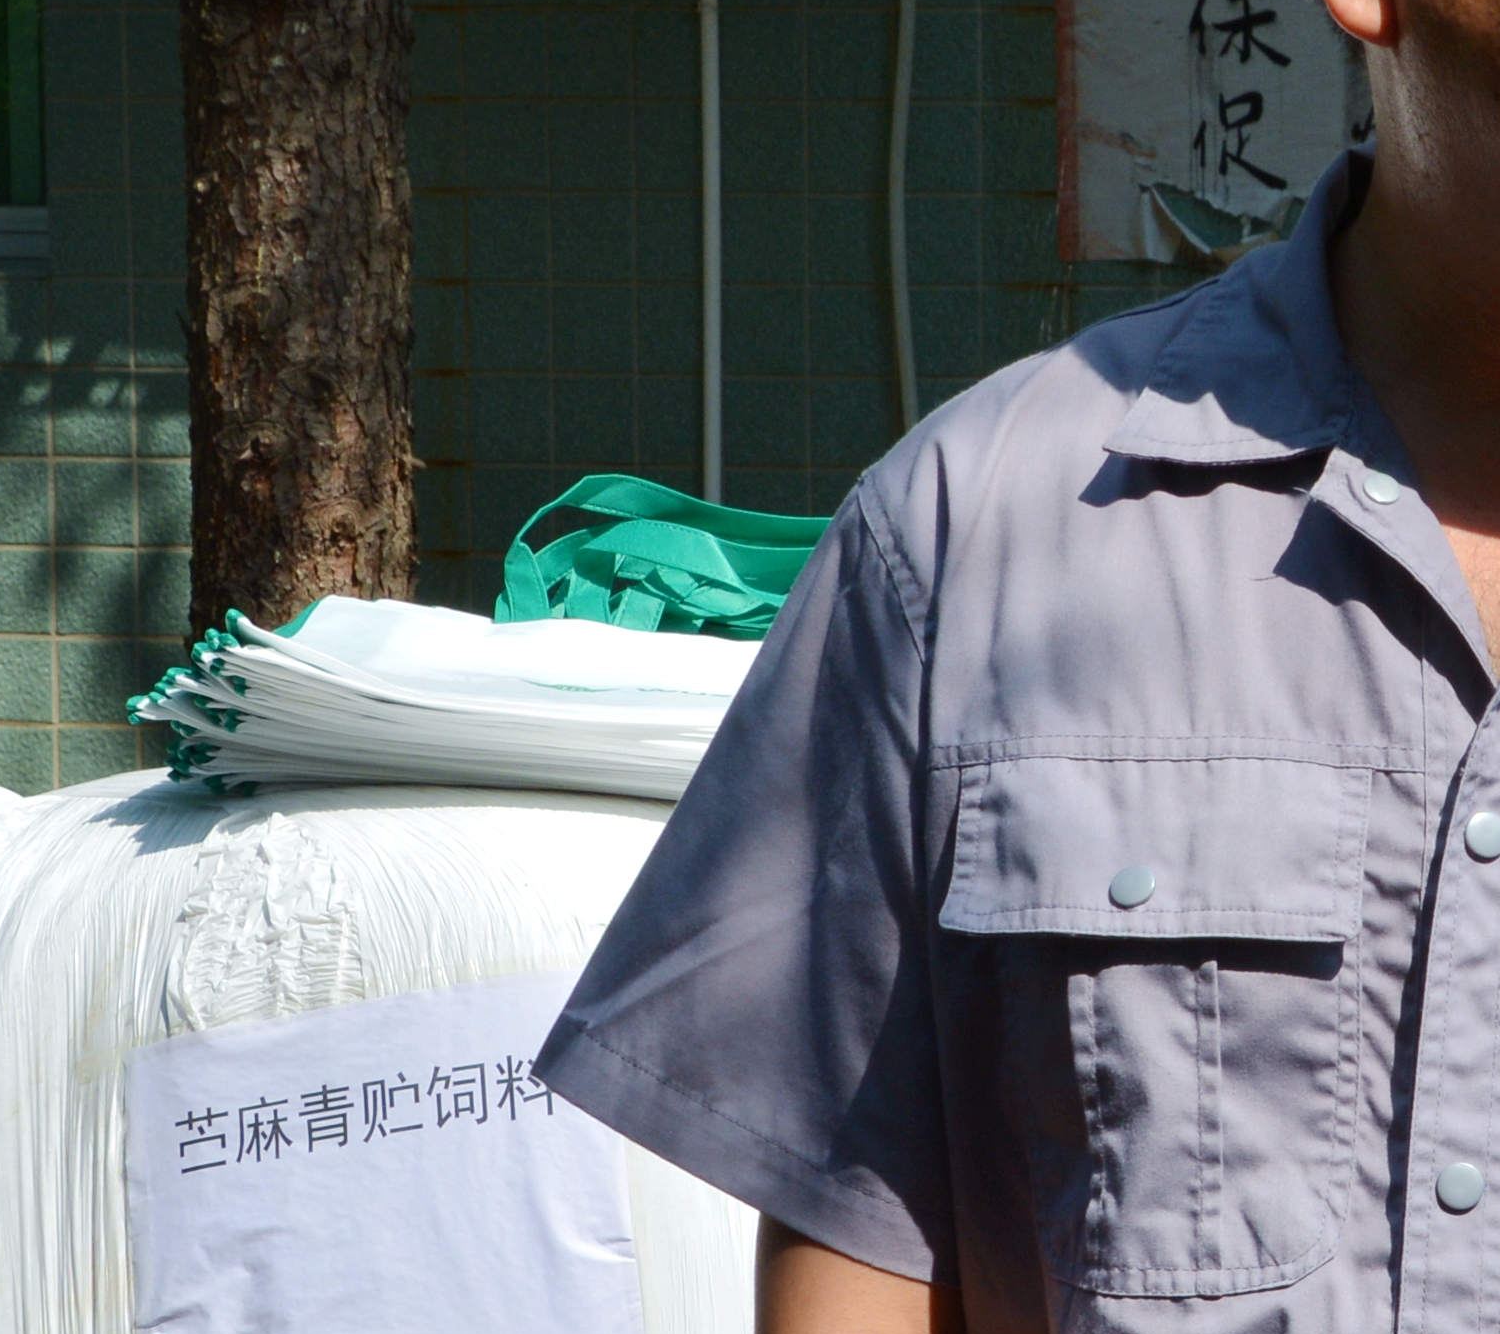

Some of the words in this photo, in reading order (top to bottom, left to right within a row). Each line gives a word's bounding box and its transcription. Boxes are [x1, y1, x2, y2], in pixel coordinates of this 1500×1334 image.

[174, 1054, 557, 1175] 苎麻青贮饲料
